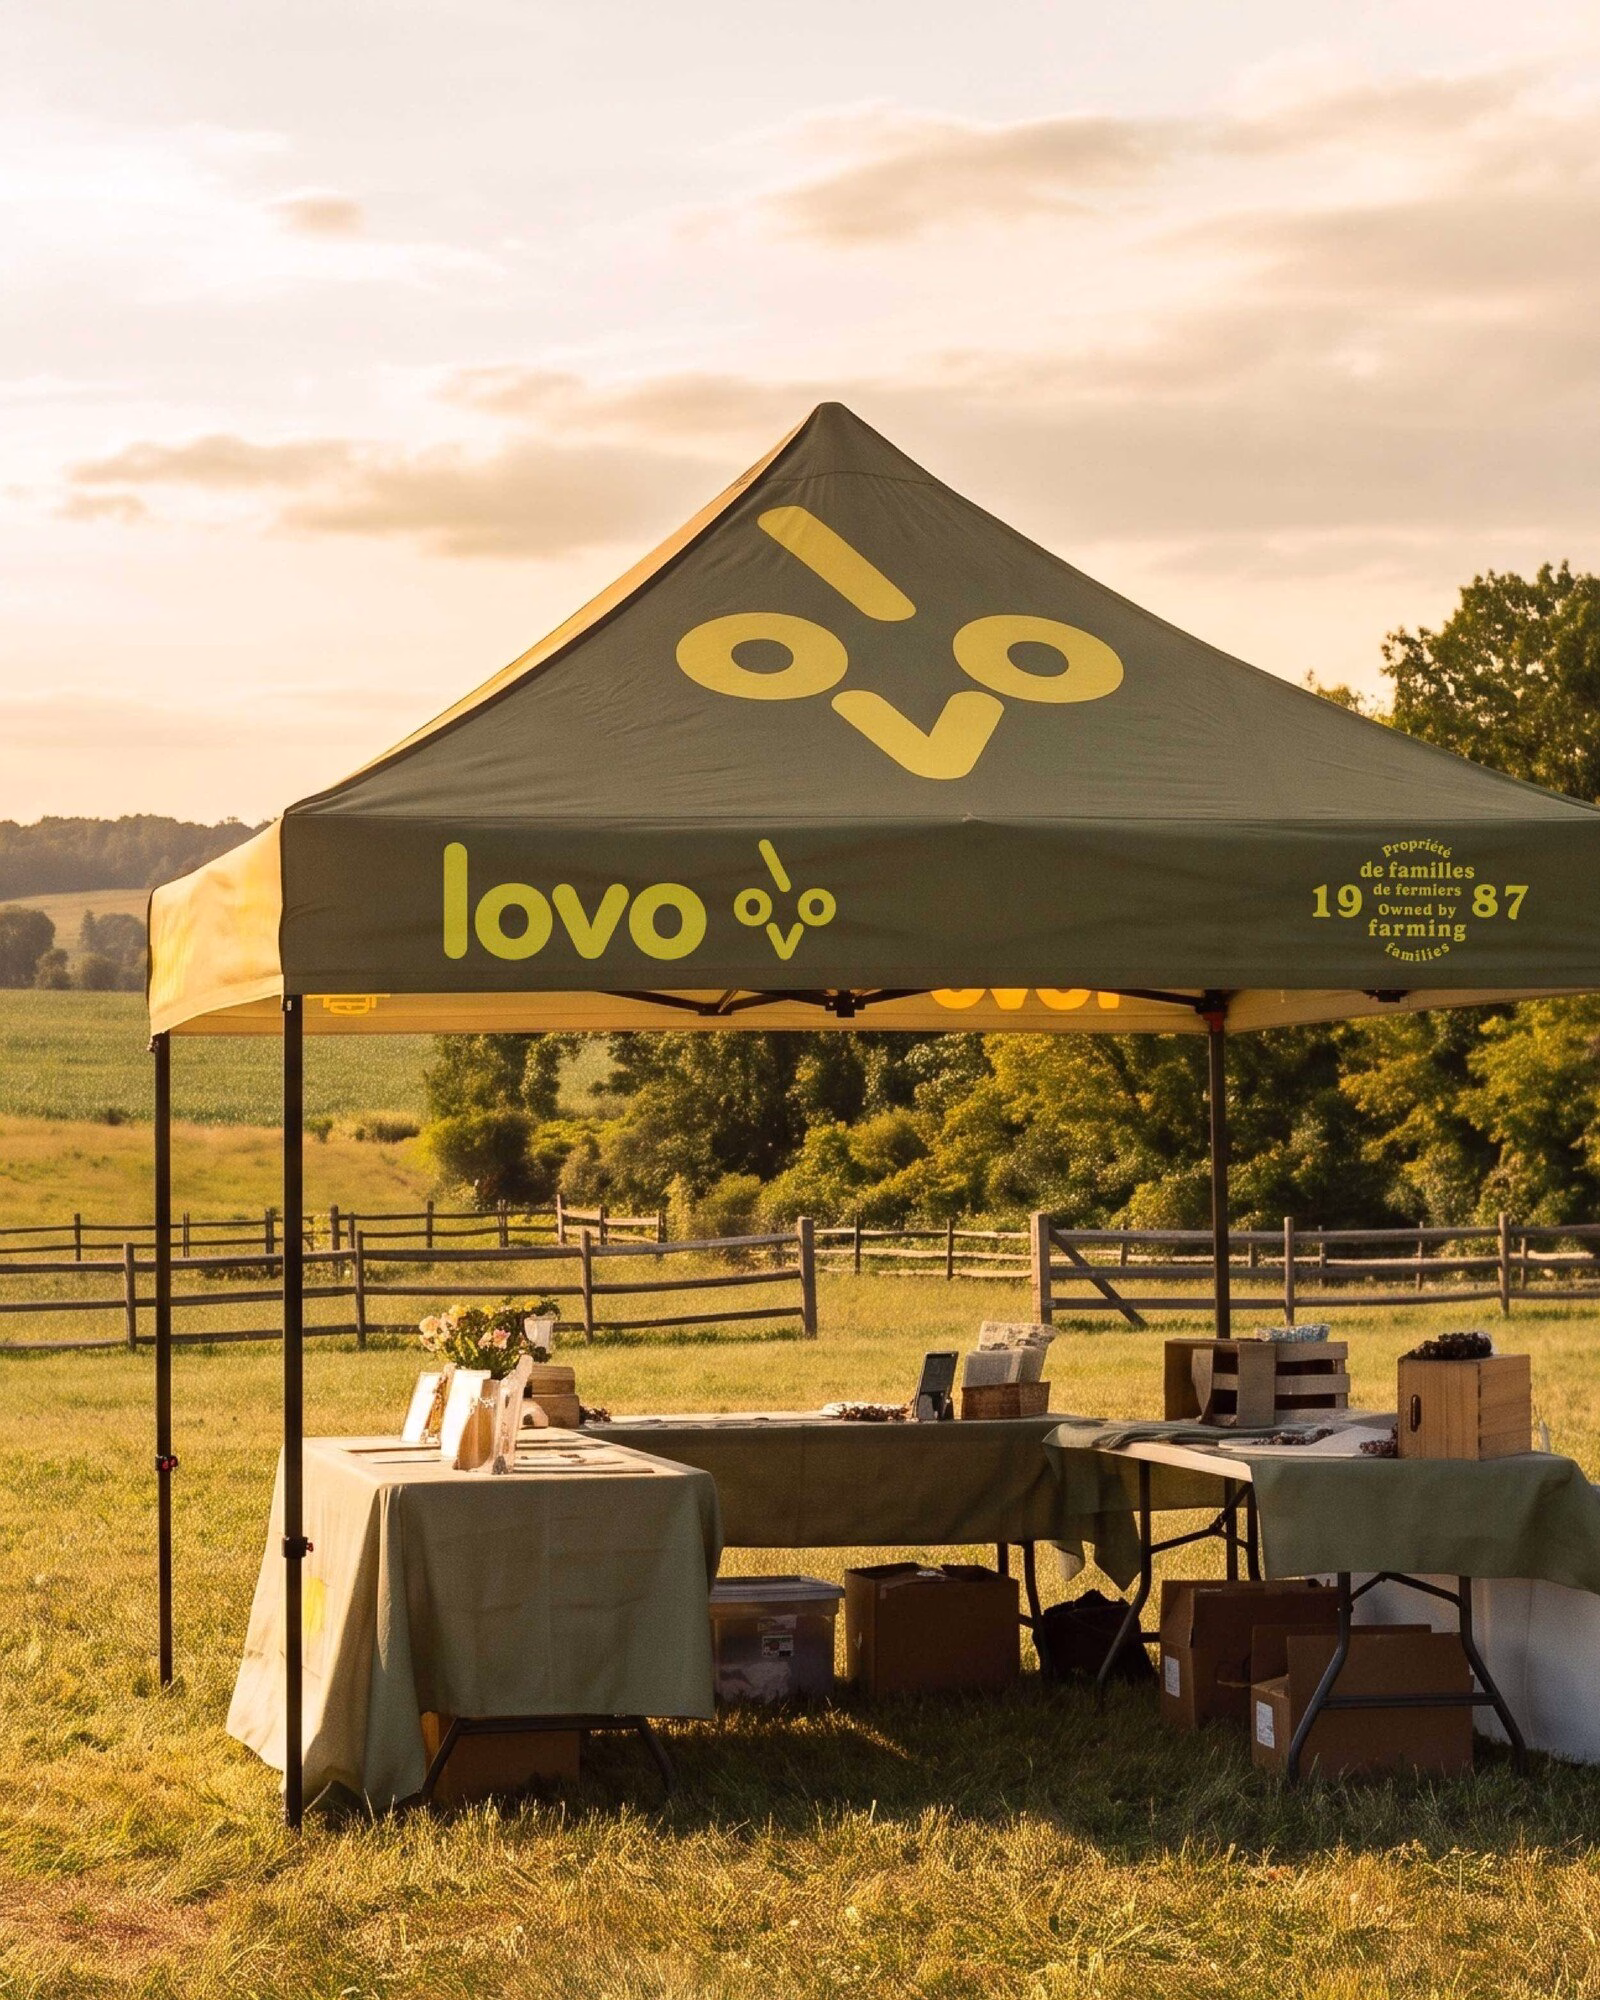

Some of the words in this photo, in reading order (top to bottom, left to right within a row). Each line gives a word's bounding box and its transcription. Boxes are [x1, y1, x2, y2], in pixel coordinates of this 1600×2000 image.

[1382, 838, 1452, 859] Propriété
[1360, 861, 1385, 879] de
[1389, 861, 1476, 880] familles
[443, 842, 708, 960] lovo
[1373, 883, 1391, 897] de
[1395, 883, 1463, 898] fermiers
[1312, 884, 1363, 919] 19
[1378, 903, 1433, 917] Owned
[1438, 903, 1457, 919] by
[1472, 884, 1529, 920] 87
[1368, 919, 1467, 943] farming
[1384, 942, 1450, 963] families
